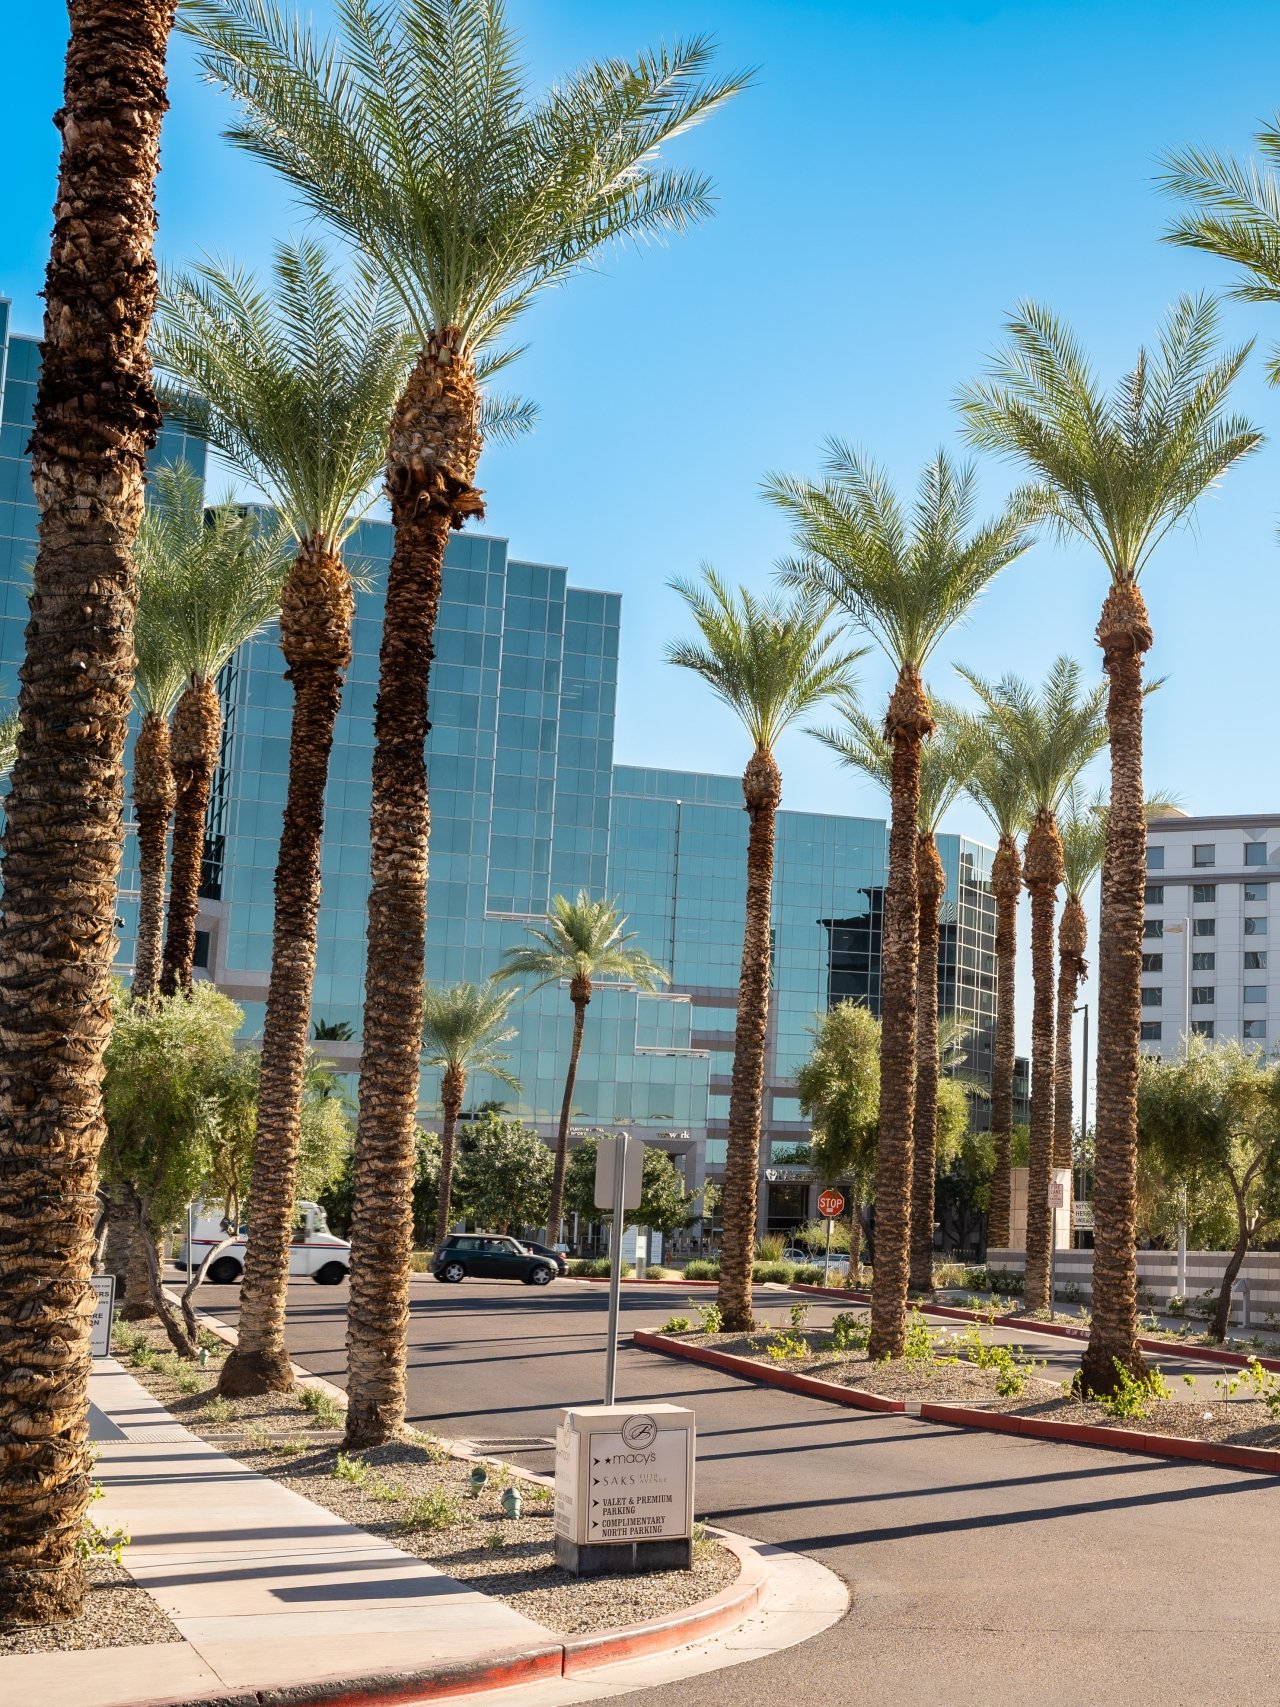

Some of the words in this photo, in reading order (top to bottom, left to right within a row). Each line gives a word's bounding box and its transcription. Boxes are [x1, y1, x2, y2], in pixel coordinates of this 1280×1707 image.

[819, 1198, 842, 1208] STOP
[613, 1451, 656, 1465] macy's
[603, 1475, 635, 1486] SAKS
[603, 1497, 626, 1506] VALET
[628, 1496, 634, 1504] &
[636, 1494, 673, 1505] PREMIUM
[602, 1506, 636, 1516] PARKING
[601, 1515, 666, 1528] COMPLIMENTARY
[601, 1527, 628, 1538] NORTH
[629, 1525, 663, 1536] PARKING
